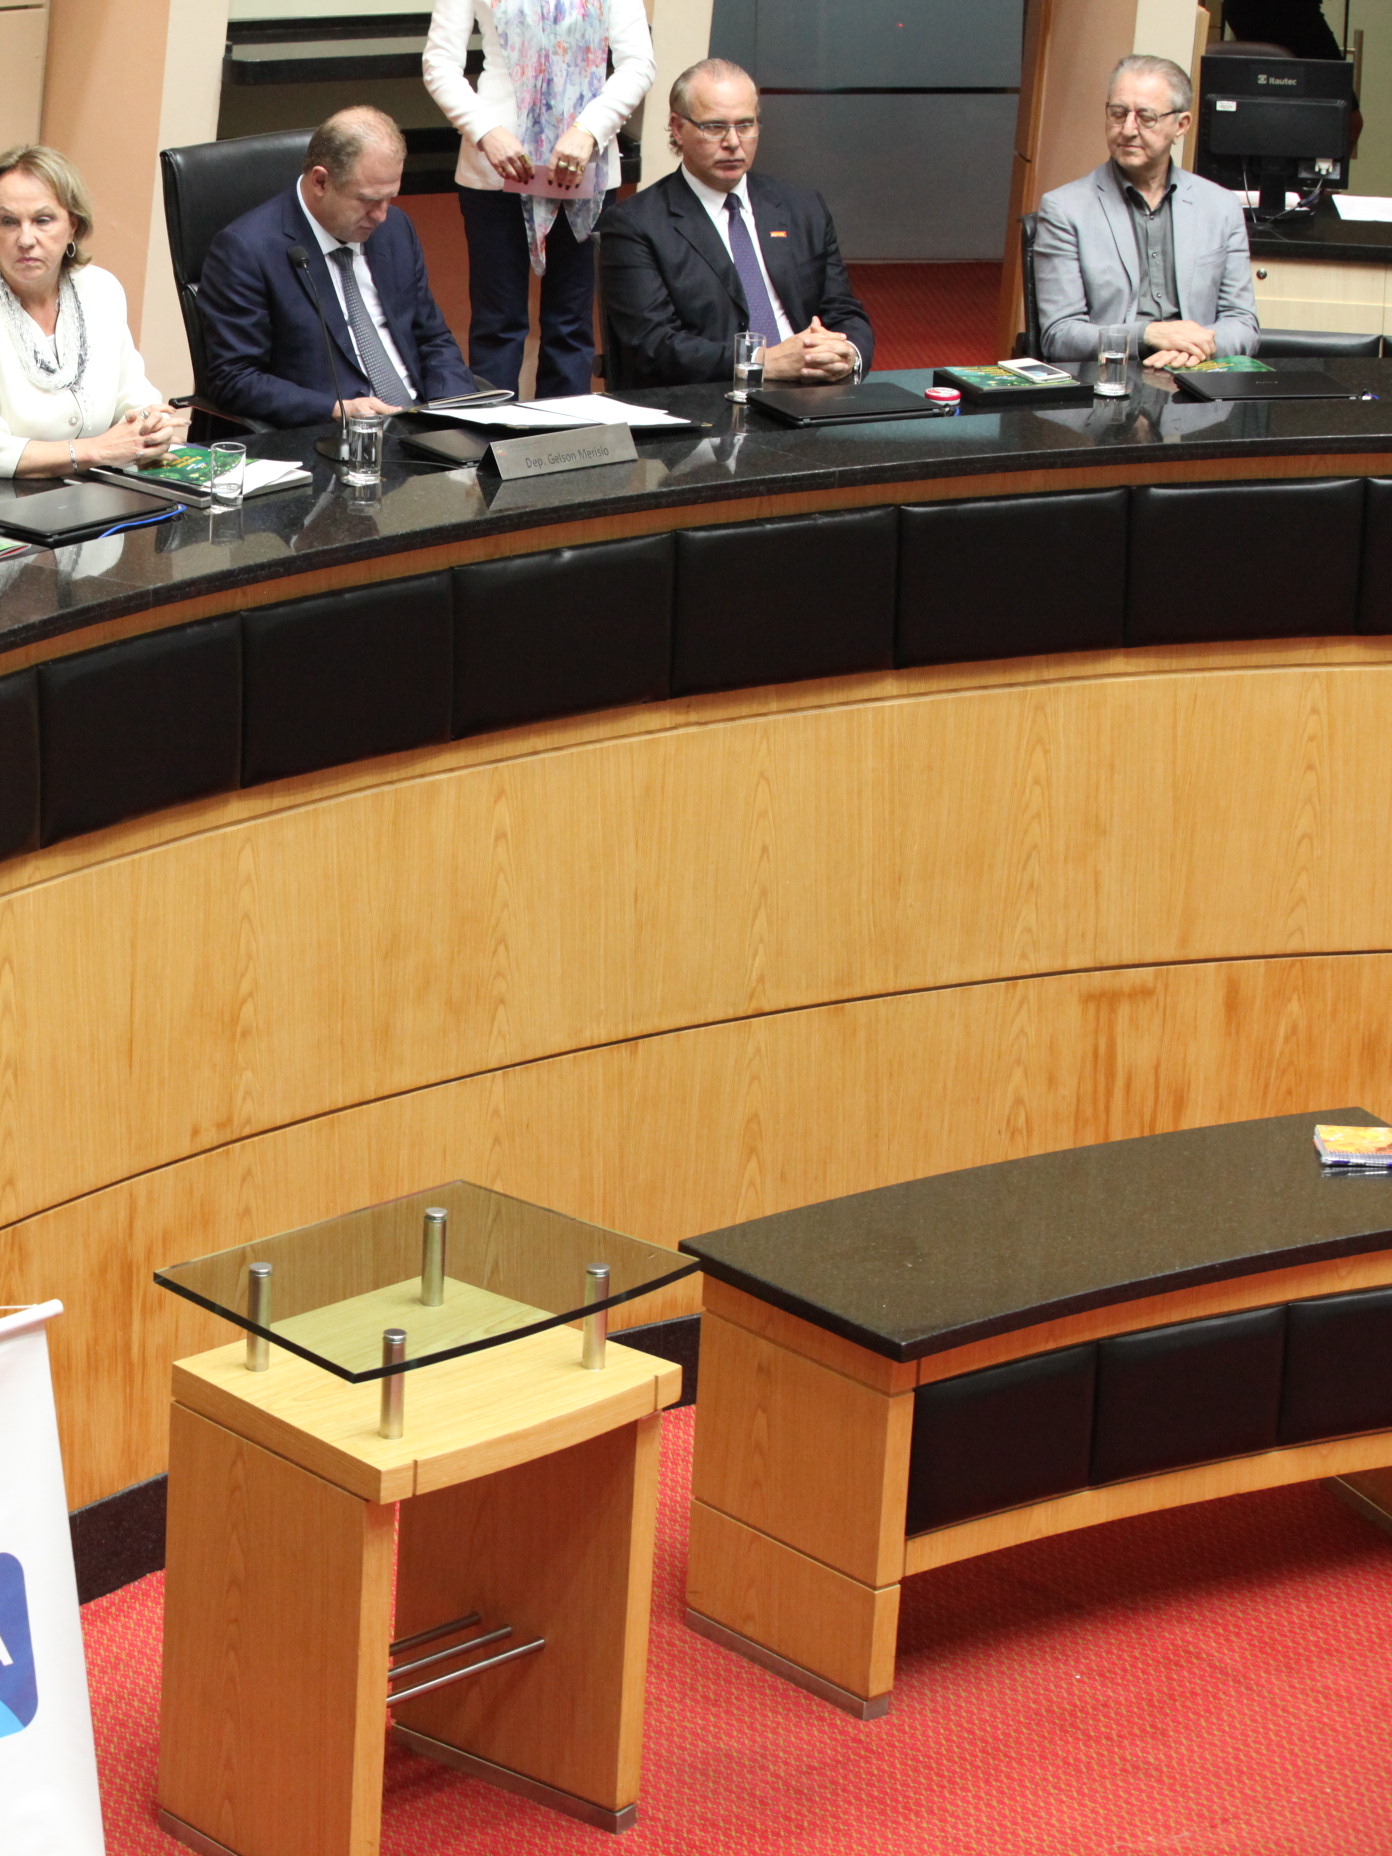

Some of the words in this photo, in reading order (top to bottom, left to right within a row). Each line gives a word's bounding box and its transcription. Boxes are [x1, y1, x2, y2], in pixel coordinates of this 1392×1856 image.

[525, 457, 547, 469] Dep.
[548, 452, 577, 465] Gelson
[577, 446, 610, 460] Merisio
